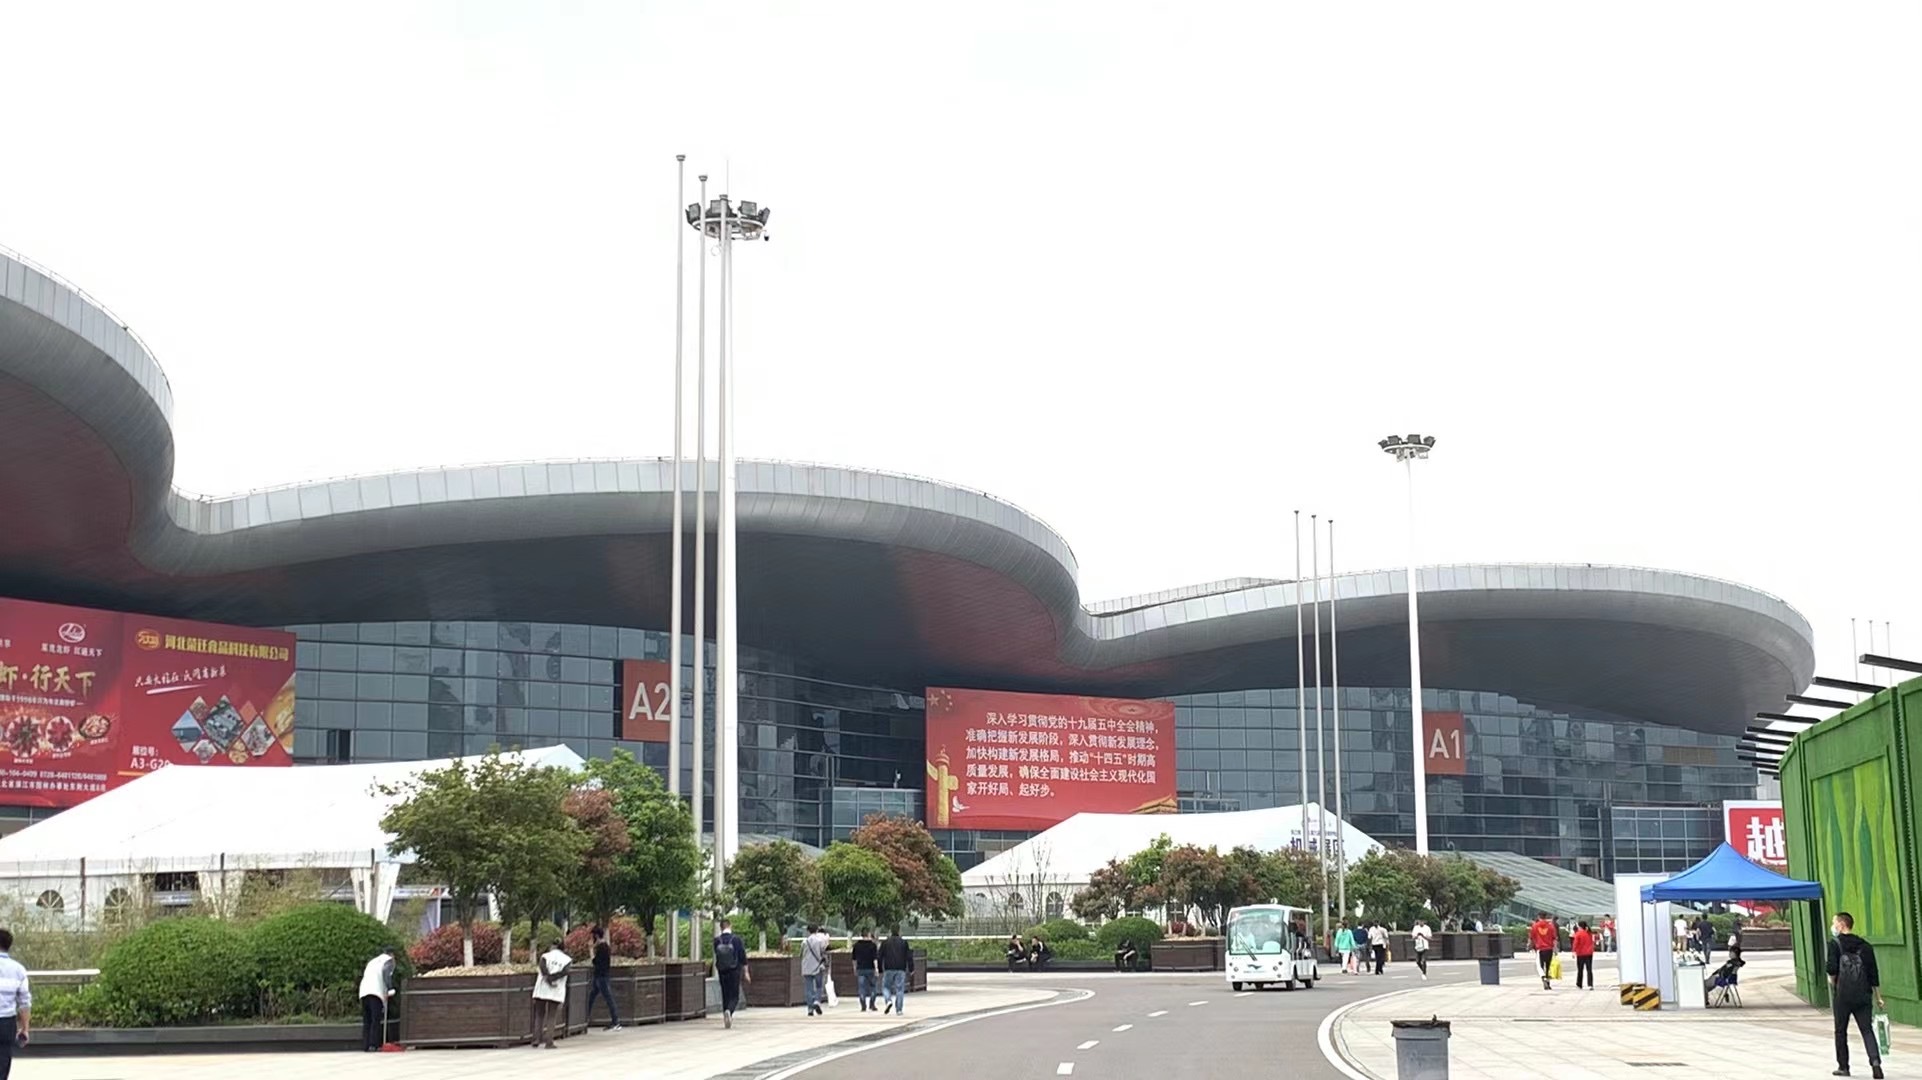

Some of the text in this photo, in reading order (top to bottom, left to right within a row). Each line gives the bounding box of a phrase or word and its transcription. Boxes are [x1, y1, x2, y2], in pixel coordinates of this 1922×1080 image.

[629, 682, 671, 720] A2
[986, 712, 1159, 734] 深入学习贯彻党的十九届五中全会精神，
[1429, 728, 1461, 759] A1
[966, 764, 1156, 784] 质量发展，确保全面建设社会主义现代化国
[966, 781, 1055, 797] 家开好局、起好步。
